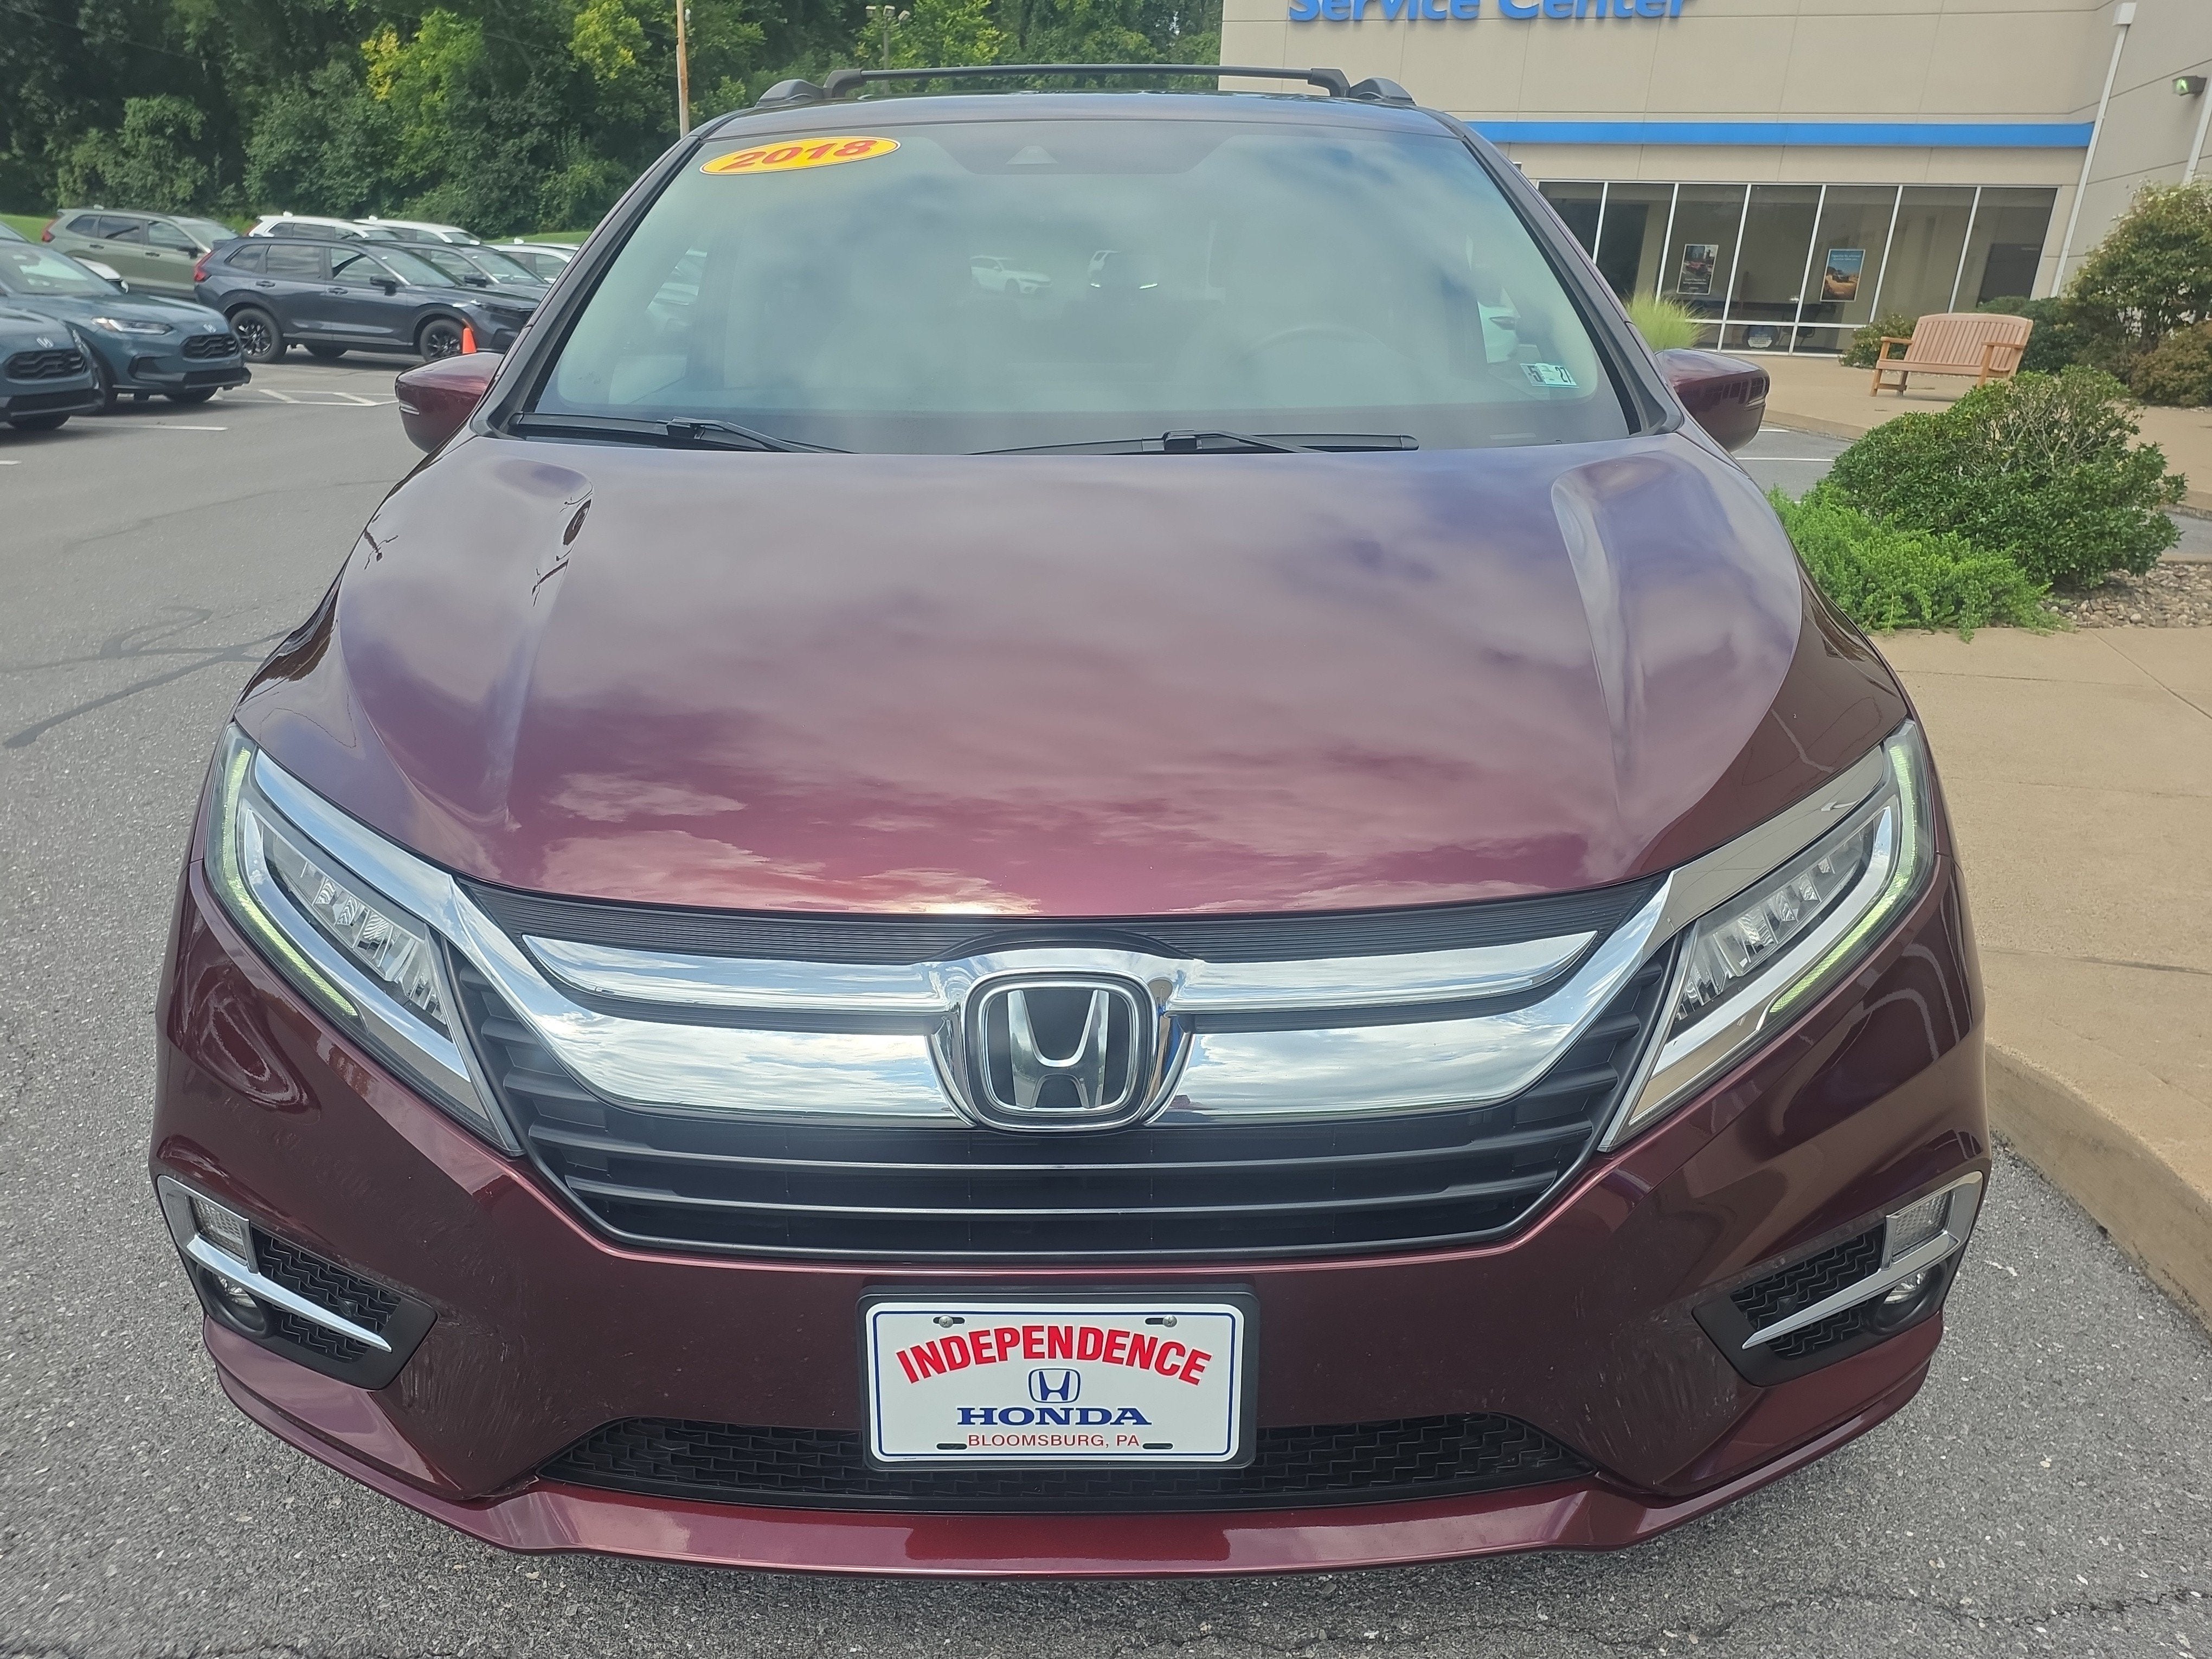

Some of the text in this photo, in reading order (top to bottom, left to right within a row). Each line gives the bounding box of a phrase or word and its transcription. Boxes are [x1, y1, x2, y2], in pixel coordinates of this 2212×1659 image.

[718, 140, 878, 172] 2018
[1554, 366, 1572, 383] 27
[895, 1325, 1213, 1386] INDEPENDENCE
[956, 1407, 1152, 1426] HONDA
[967, 1434, 1140, 1448] BLOOMSBURG, PA
